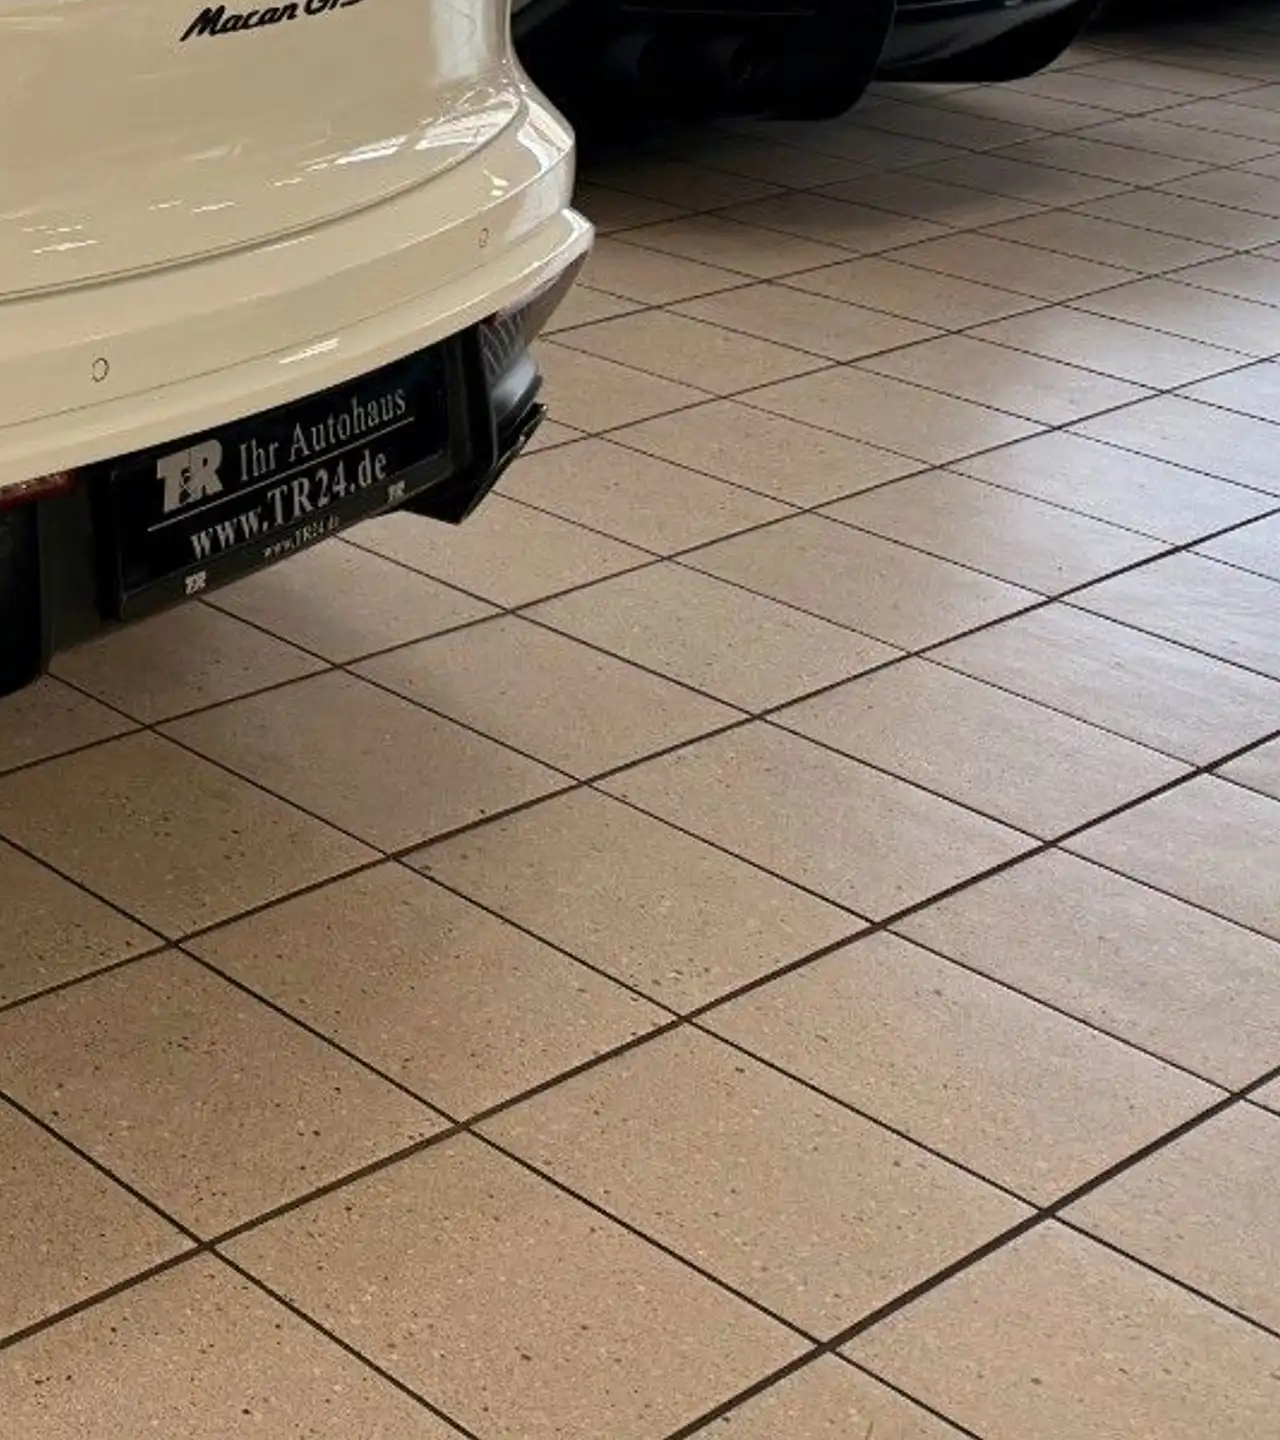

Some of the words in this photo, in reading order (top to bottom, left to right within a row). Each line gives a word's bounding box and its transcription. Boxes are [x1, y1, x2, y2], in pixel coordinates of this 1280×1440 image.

[179, 3, 300, 42] Macan
[238, 437, 281, 481] Ihr
[287, 388, 407, 464] Autohaus
[189, 449, 389, 561] www.TR24.de
